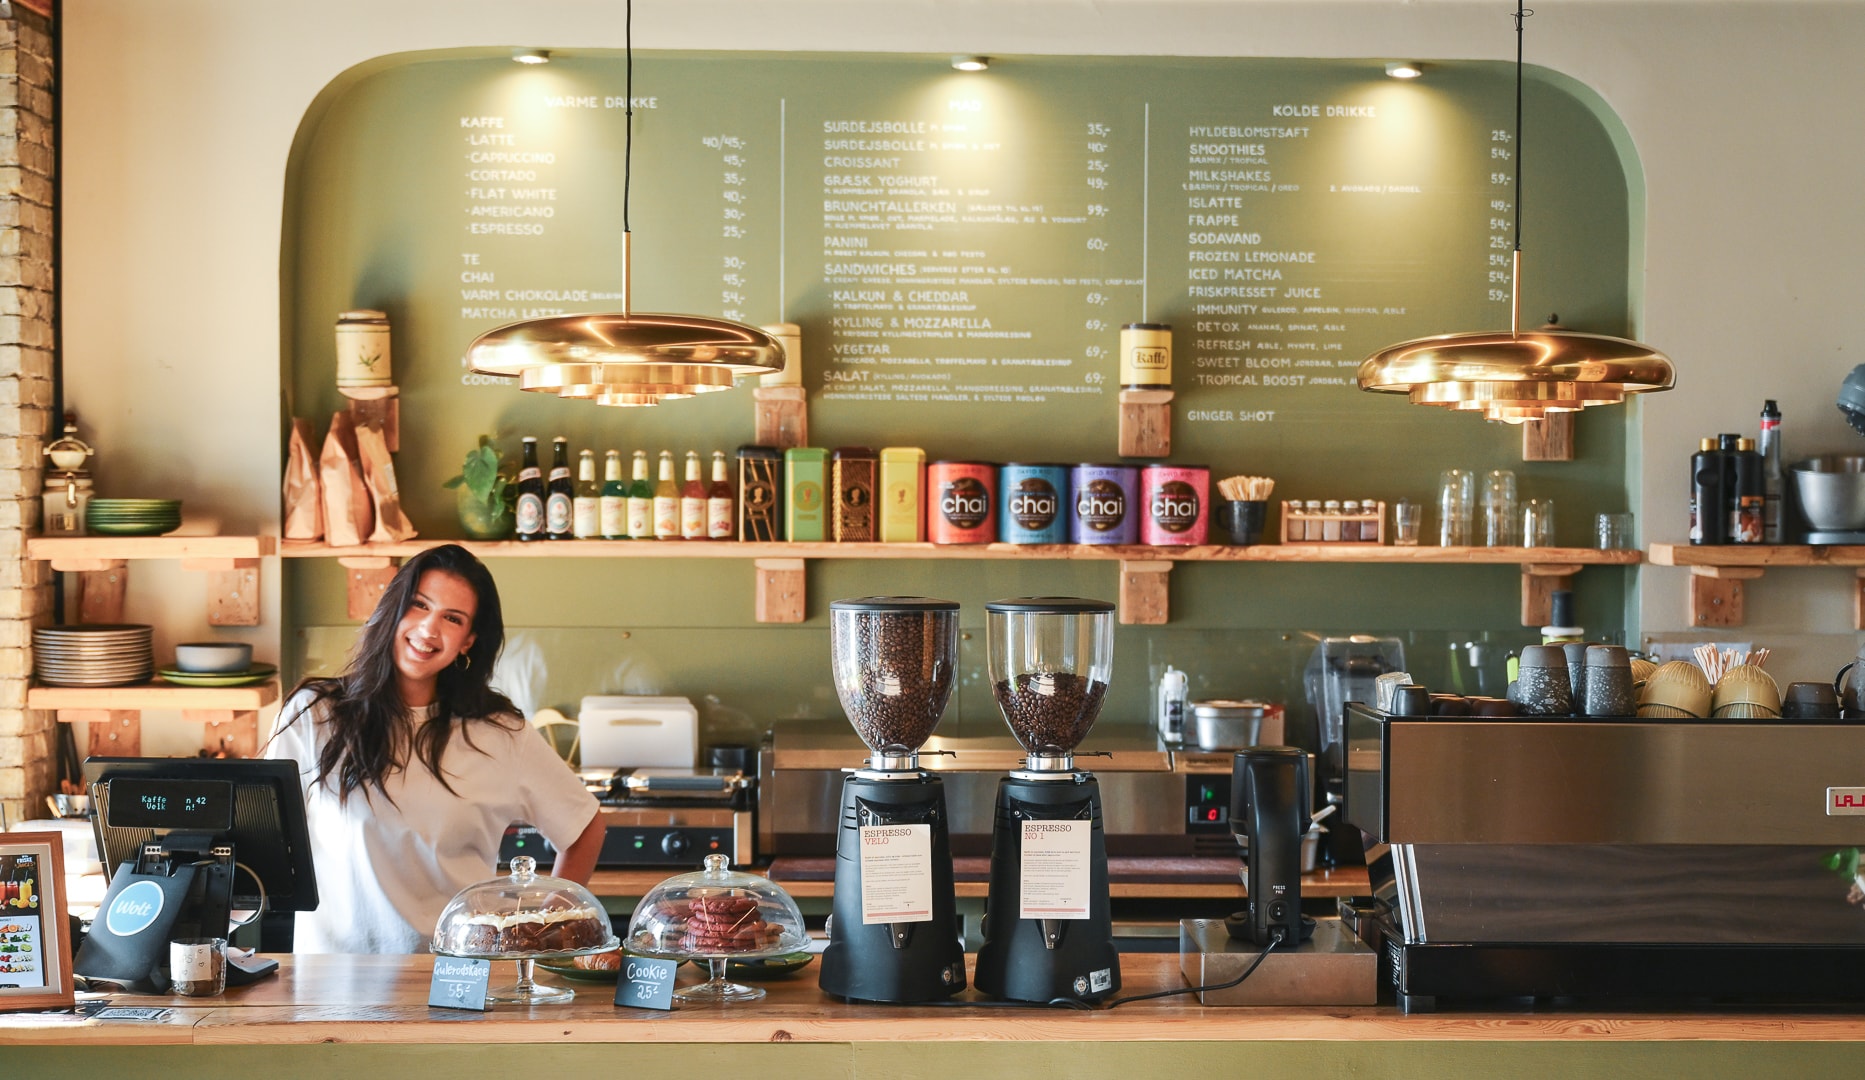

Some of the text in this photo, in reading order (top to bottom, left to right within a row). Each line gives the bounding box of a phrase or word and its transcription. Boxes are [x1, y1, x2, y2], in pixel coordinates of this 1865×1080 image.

[544, 96, 658, 109] VARME DRKKE
[948, 99, 981, 112] MAD
[1272, 104, 1376, 117] KOLDE DRIKKE
[460, 117, 504, 129] KAFFE
[823, 120, 926, 134] SURDEJSBOLLE
[1188, 126, 1310, 138] HYLDEBLOMSTSAFT
[470, 134, 515, 146] LATTE
[823, 139, 925, 152] SURDEJSBOLLE
[1188, 144, 1266, 156] SMOOTHIES
[470, 151, 555, 164] CAPPUCCINO
[823, 156, 901, 168] CROISSANT
[1229, 157, 1269, 165] TROPICAL
[470, 170, 536, 182] CORTADO
[823, 175, 872, 187] GRÆSK
[878, 175, 938, 187] YOGHURT
[1188, 170, 1272, 182] MILKSHAKES
[470, 188, 506, 200] FLAT
[511, 188, 557, 201] WHITE
[823, 200, 957, 213] BRUNCHTALLERKEN
[1188, 196, 1242, 208] ISLATTE
[470, 205, 555, 218] AMERICANO
[1188, 214, 1239, 227] FRAPPE
[470, 223, 544, 235] ESPRESSO
[823, 236, 868, 248] PANINI
[1188, 232, 1262, 244] SODAVAND
[461, 253, 481, 265] TE
[1188, 251, 1239, 262] FROZEN
[1244, 252, 1316, 263] LEMONADE
[823, 263, 917, 275] SANDWICHES
[1188, 268, 1218, 280] ICED
[1224, 268, 1283, 281] MATCHA
[461, 271, 495, 283] CHAI
[461, 289, 500, 301] VARM
[505, 290, 589, 302] CHOKOLADE
[832, 290, 886, 302] KALKUN
[892, 290, 903, 302] &
[908, 290, 969, 302] CHEDDAR
[1188, 286, 1277, 298] FRISKPRESSET
[1284, 287, 1322, 298] JUICE
[461, 307, 517, 319] MATCHA
[1196, 304, 1258, 315] IMMUNITY
[832, 316, 884, 328] KYLLING
[890, 317, 900, 328] &
[903, 317, 992, 329] MOZZARELLA
[1196, 322, 1240, 333] DETOX
[832, 343, 891, 355] VEGETAR
[1196, 340, 1251, 350] REFRESH
[1196, 358, 1240, 368] SWEET
[1245, 358, 1291, 369] BLOOM
[461, 374, 513, 386] COOKIE
[823, 369, 870, 382] SALAT
[1197, 374, 1259, 386] TROPICAL
[1263, 375, 1305, 387] BOOST
[1187, 411, 1276, 422] GINGER SHOT
[942, 494, 986, 513] chai
[1010, 495, 1055, 514] chai
[1078, 497, 1122, 515] chai
[1151, 498, 1196, 516] chai
[141, 795, 167, 804] Kaffe
[195, 796, 207, 805] 42
[864, 828, 912, 838] ESPRESSO
[1025, 824, 1072, 833] ESPRESSO
[864, 837, 889, 845] VELO
[115, 900, 152, 916] Wolt
[626, 962, 668, 980] Cookie
